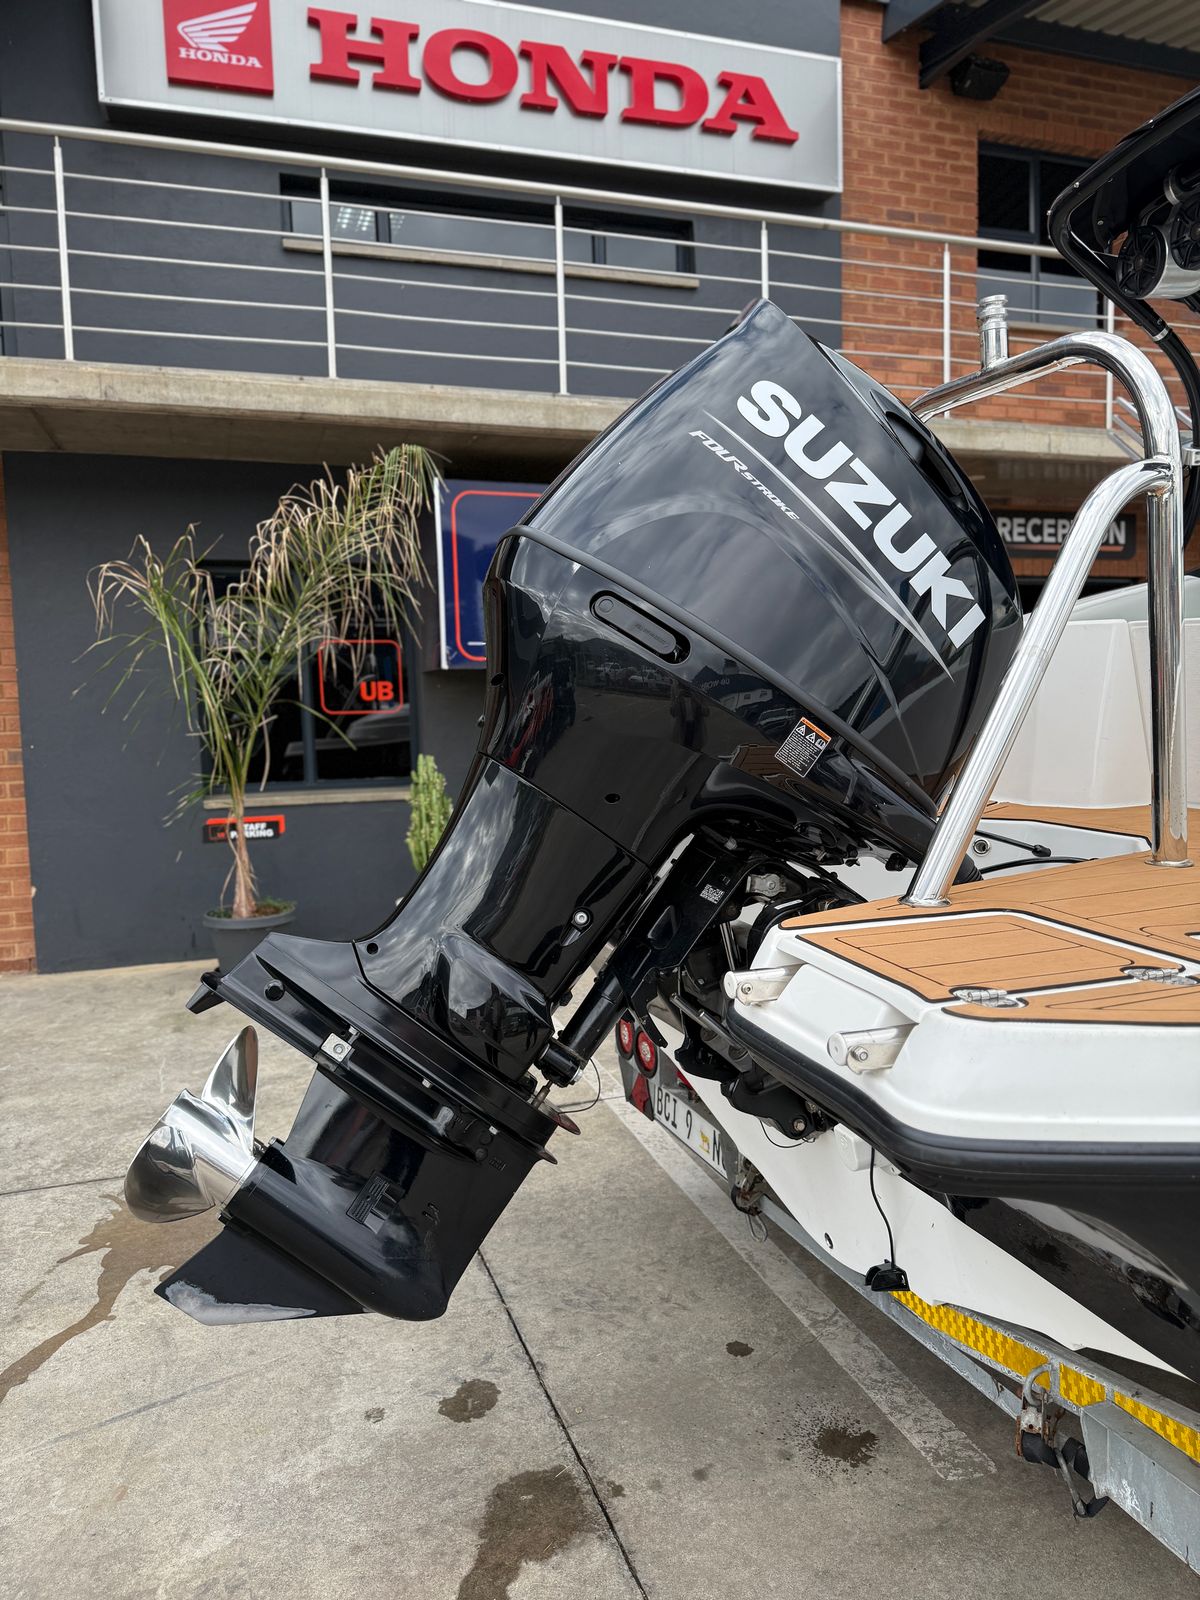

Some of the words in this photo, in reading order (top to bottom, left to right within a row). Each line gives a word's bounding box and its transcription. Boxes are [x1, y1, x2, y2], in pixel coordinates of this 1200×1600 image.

[178, 47, 263, 69] HONDA
[307, 7, 800, 145] HONDA
[737, 380, 987, 649] SUZUKI
[997, 516, 1127, 546] RECEPN
[360, 681, 394, 702] UB
[656, 1087, 677, 1129] BCI
[686, 1109, 693, 1139] 9
[712, 1129, 726, 1170] N
